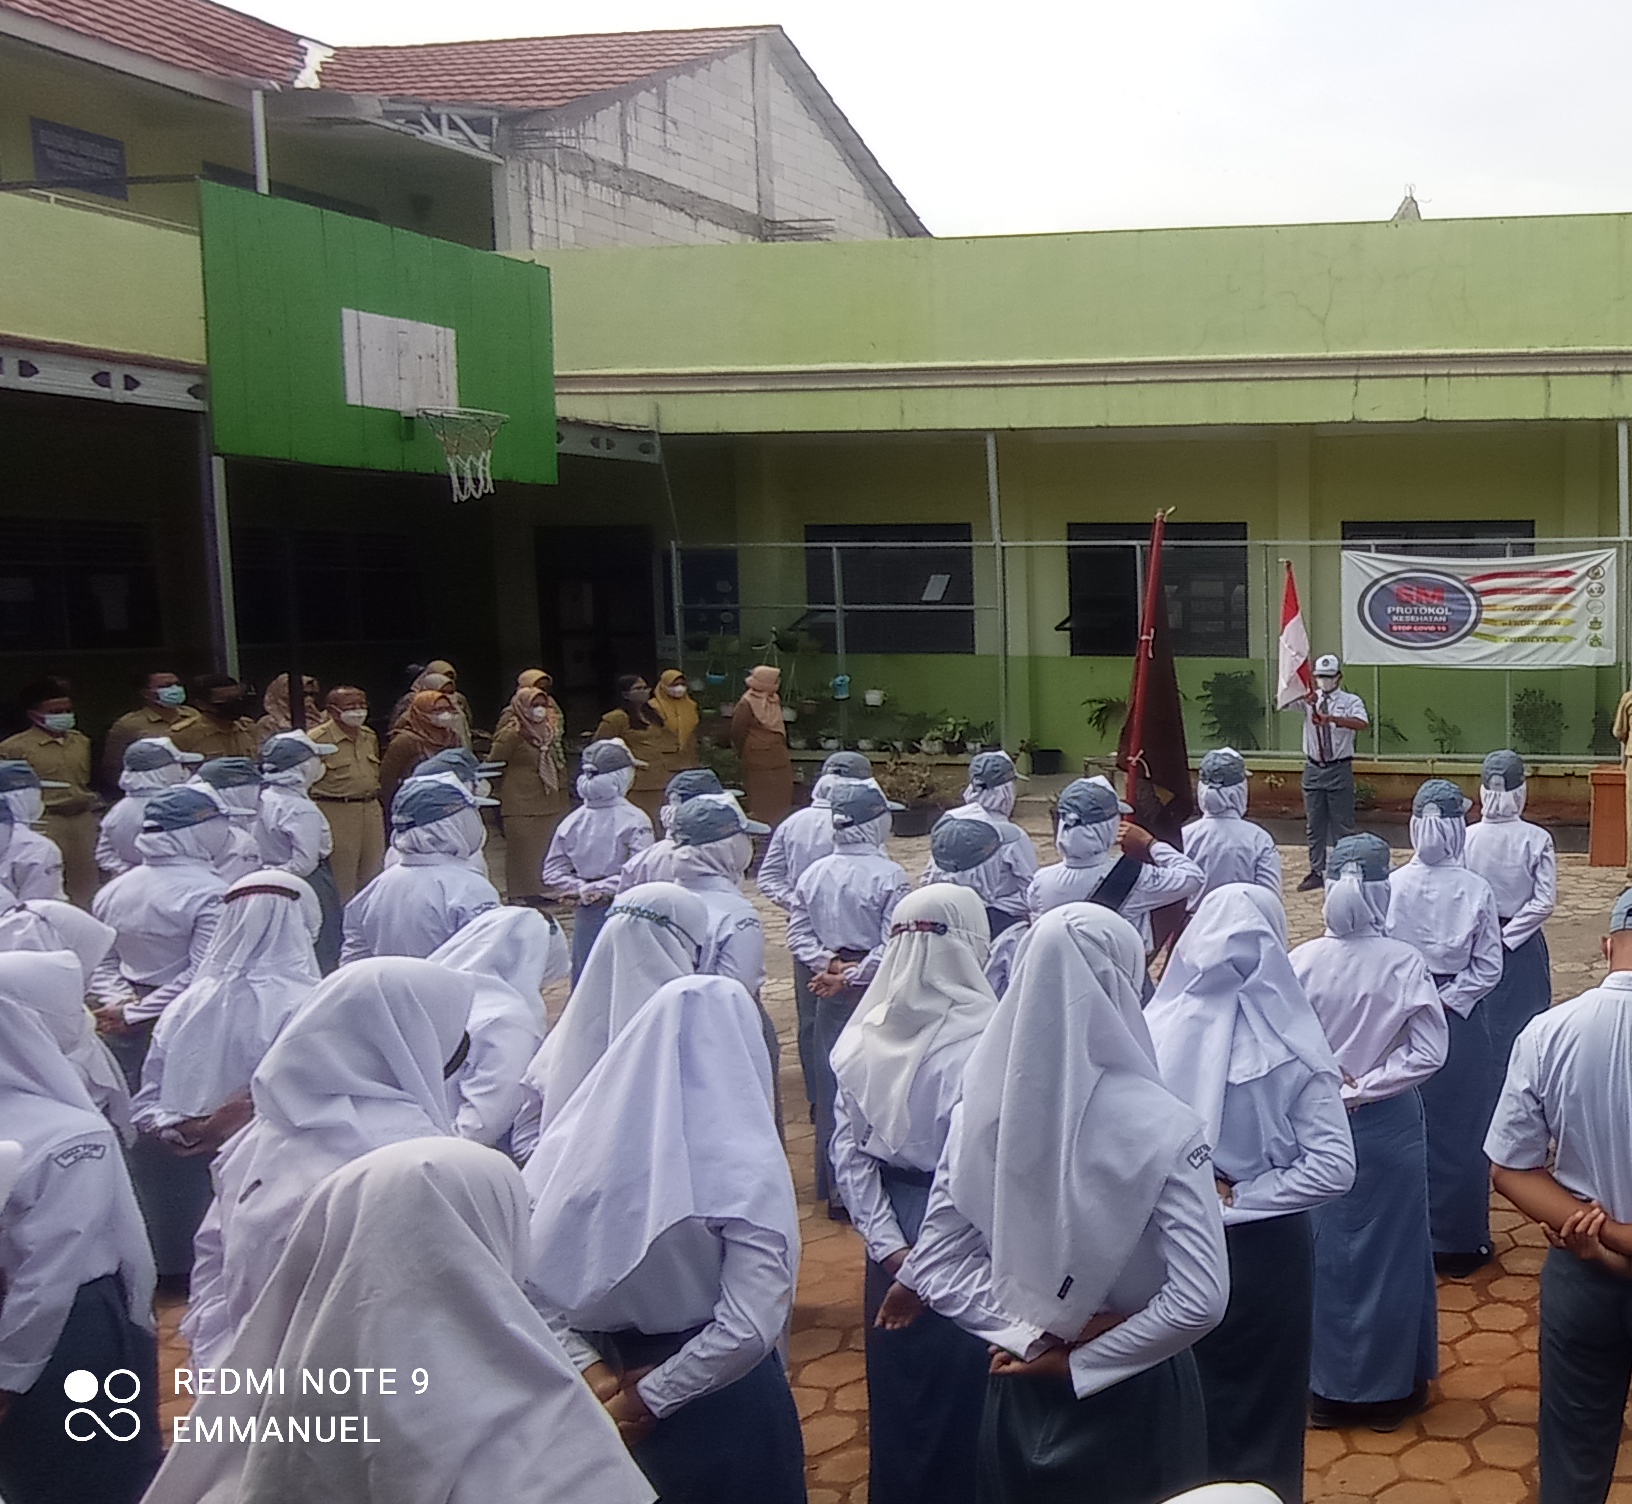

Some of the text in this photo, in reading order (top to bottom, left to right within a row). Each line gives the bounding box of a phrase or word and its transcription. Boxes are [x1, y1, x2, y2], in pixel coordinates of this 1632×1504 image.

[1386, 605, 1453, 616] PROTOKOL
[1391, 615, 1447, 623] KESEHATAN
[1392, 624, 1413, 632] STOP
[1413, 624, 1437, 632] COVID
